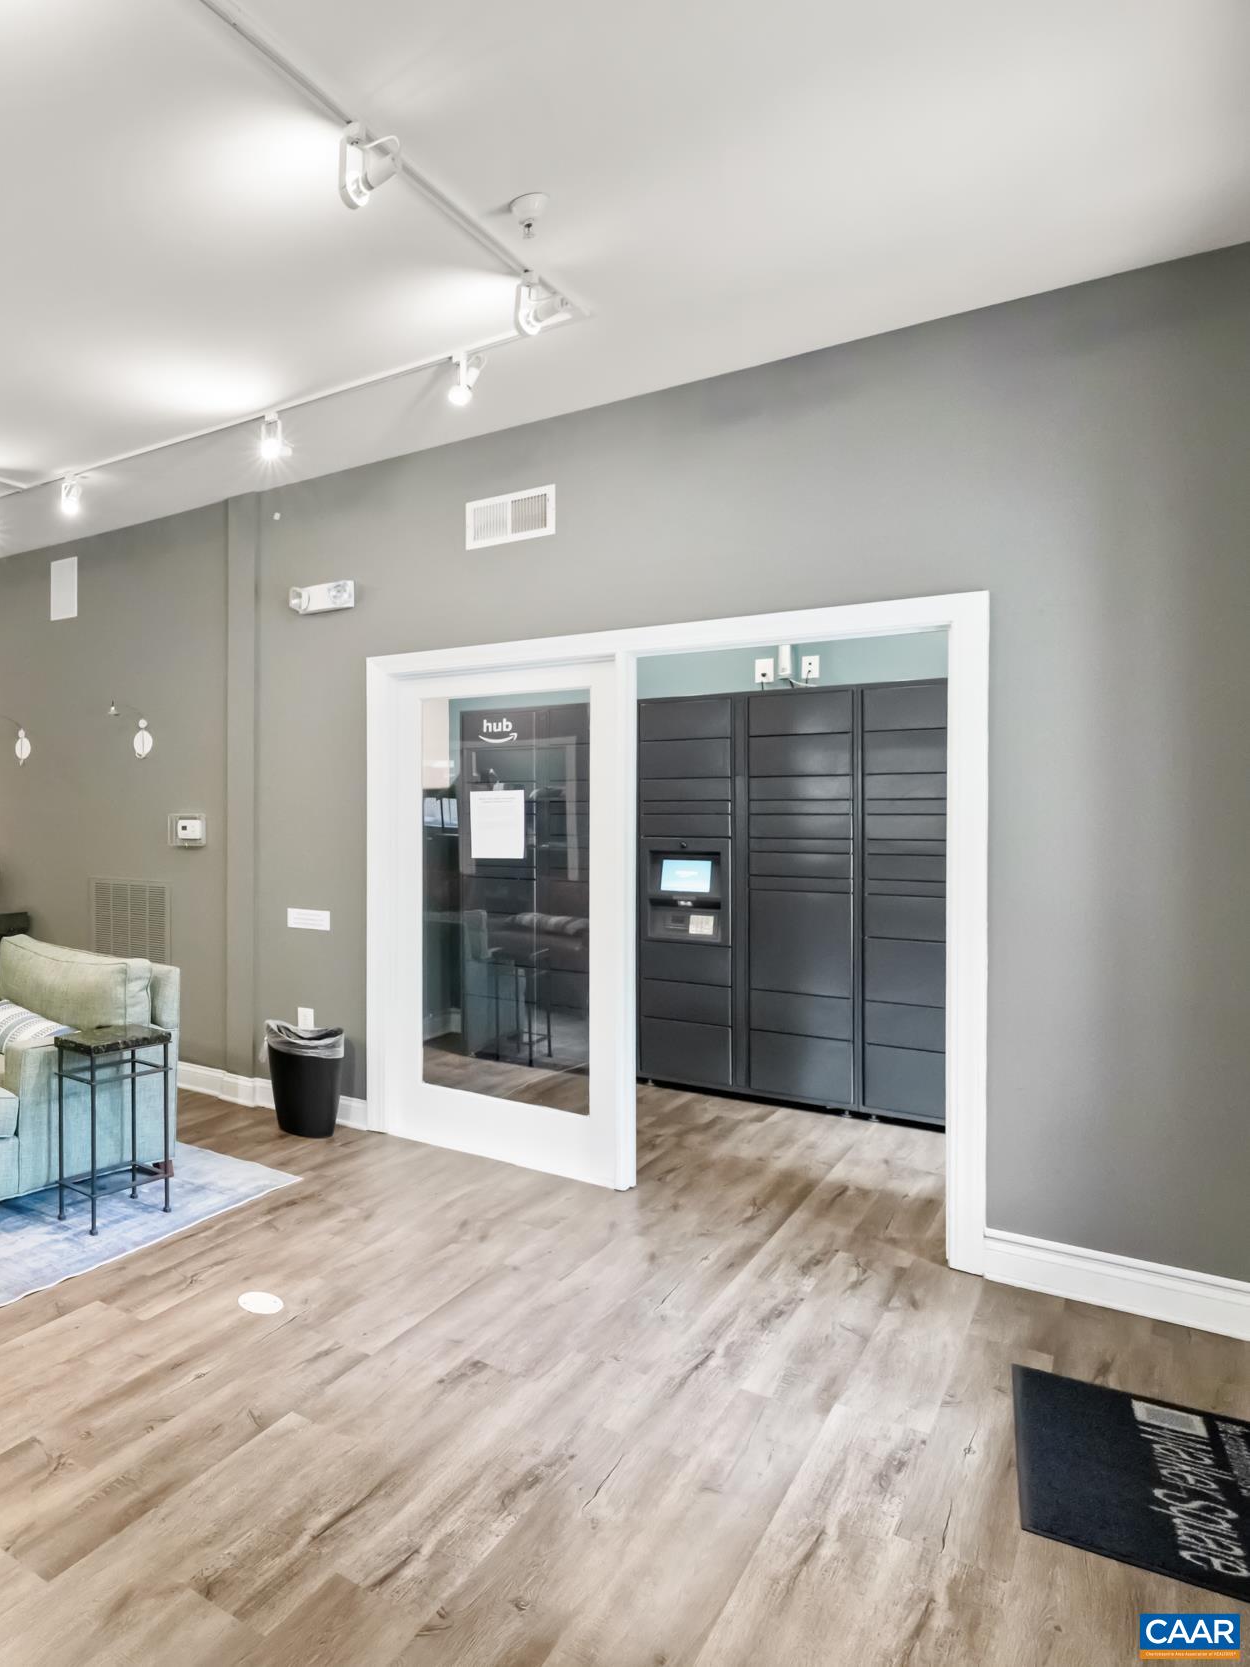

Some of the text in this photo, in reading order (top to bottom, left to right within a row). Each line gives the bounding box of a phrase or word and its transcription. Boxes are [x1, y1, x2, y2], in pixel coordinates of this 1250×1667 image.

[483, 718, 512, 732] hub
[1138, 1424, 1250, 1577] Walker Square
